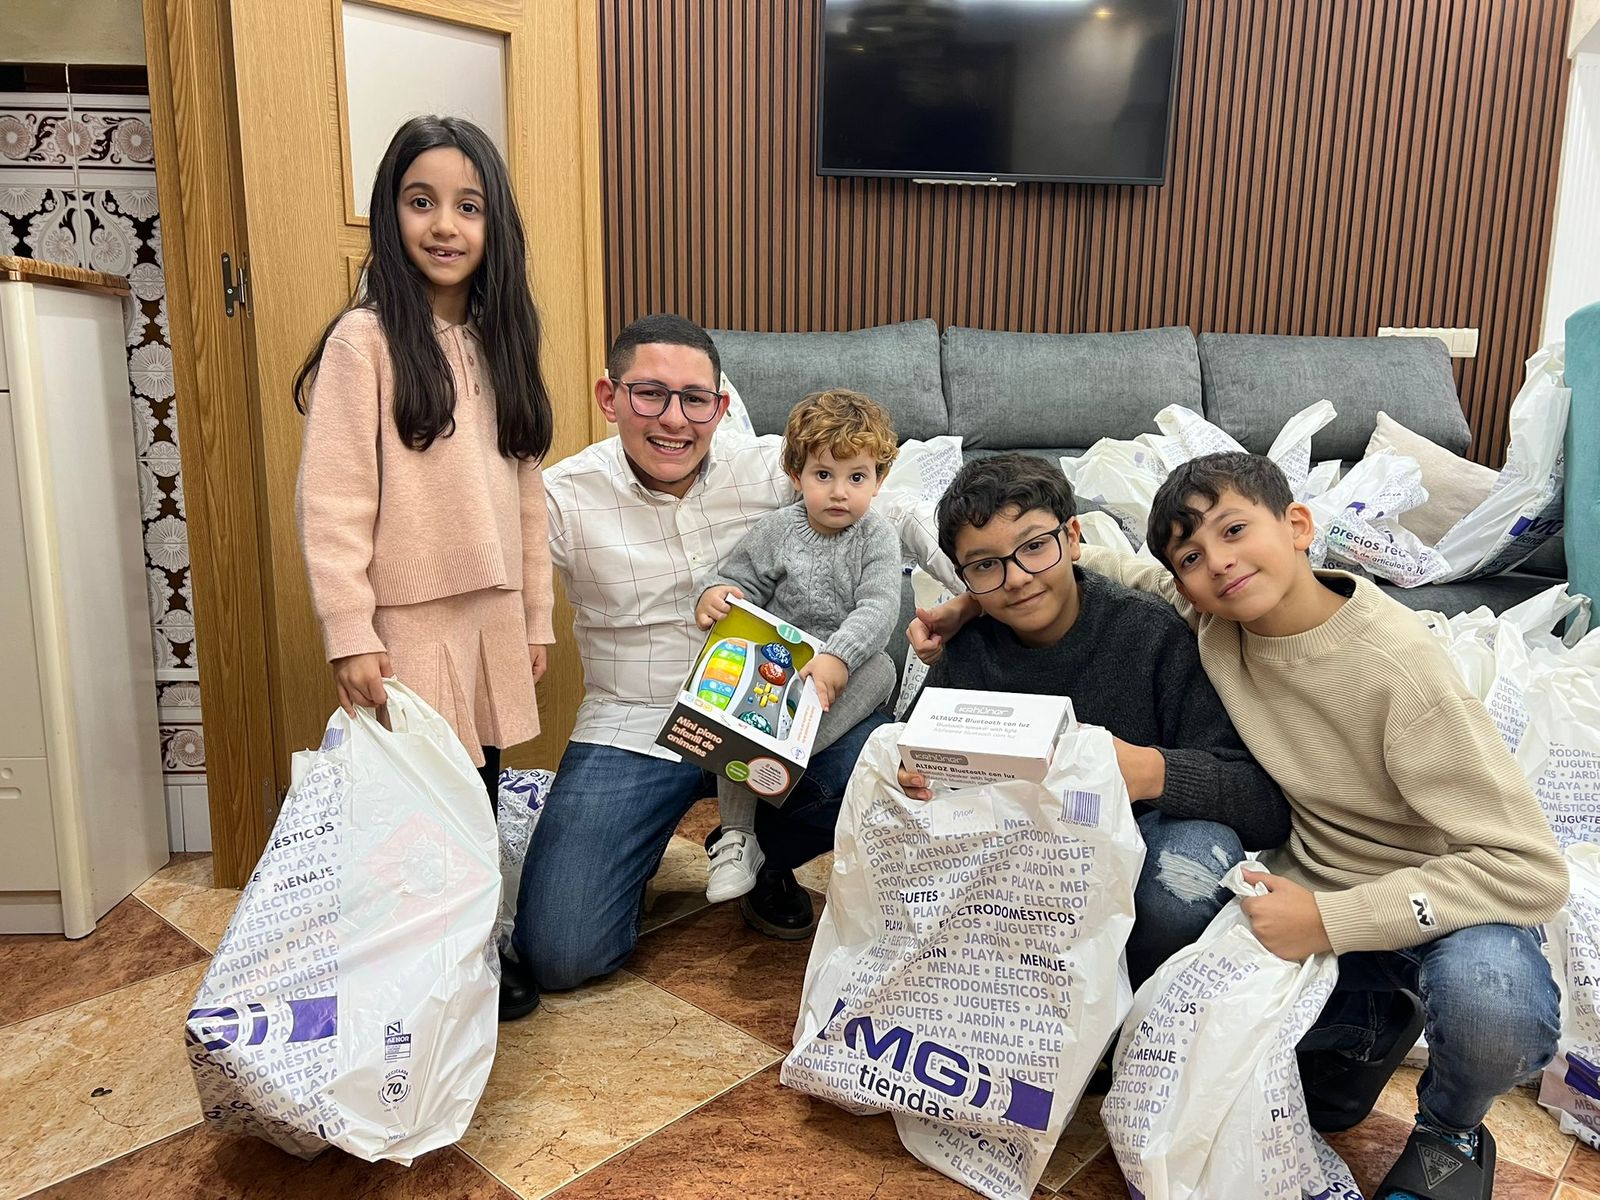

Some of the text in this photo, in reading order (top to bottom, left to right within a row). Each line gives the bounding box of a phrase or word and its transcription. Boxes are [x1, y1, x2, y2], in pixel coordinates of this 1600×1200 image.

[1329, 525, 1380, 551] precios
[676, 716, 723, 744] Mini piano
[930, 714, 964, 723] ALTAVOZ
[667, 733, 707, 758] animales
[671, 723, 715, 751] infantil de
[916, 763, 948, 772] ALTAVOZ
[950, 766, 987, 776] Bluetooth
[1547, 780, 1581, 791] PLAYA
[916, 842, 970, 861] MENAJE
[278, 853, 328, 875] PLAYA
[946, 860, 1011, 885] JUGUETES
[1022, 861, 1065, 877] JARDÍN
[273, 866, 335, 893] MENAJE
[1011, 875, 1045, 893] PLAYA
[913, 904, 952, 919] PLAYA
[962, 888, 1014, 905] MENAJE
[1023, 894, 1088, 910] ELECTRO
[938, 902, 1076, 930] ELECTRODOMÉSTICOS
[994, 920, 1057, 938] JUGUETES
[210, 929, 337, 978] JARDÍN PLAYA
[964, 932, 1061, 955] JARDÍN PLAYA
[231, 944, 340, 988] MENAJE ELE
[927, 961, 981, 977] MENAJE
[961, 948, 1004, 963] PLAYA
[1020, 953, 1067, 972] MENAJE
[904, 975, 1048, 1000] ELECTRODOMÉSTICOS
[953, 994, 1020, 1014] JUGUETES
[879, 1004, 1064, 1036] JUGUETES JARDÍN PLAYA
[916, 1023, 1064, 1053] PLAYA MENAJE ELE
[1149, 1032, 1176, 1046] LAYA
[1134, 1048, 1177, 1064] MENAJE
[250, 1063, 323, 1102] JUGUETES
[859, 1063, 956, 1122] tiendas
[1123, 1115, 1151, 1131] PLAYA
[939, 1127, 975, 1159] PLAYA
[1132, 1133, 1149, 1148] ELE
[1424, 1149, 1454, 1169] GUESS
